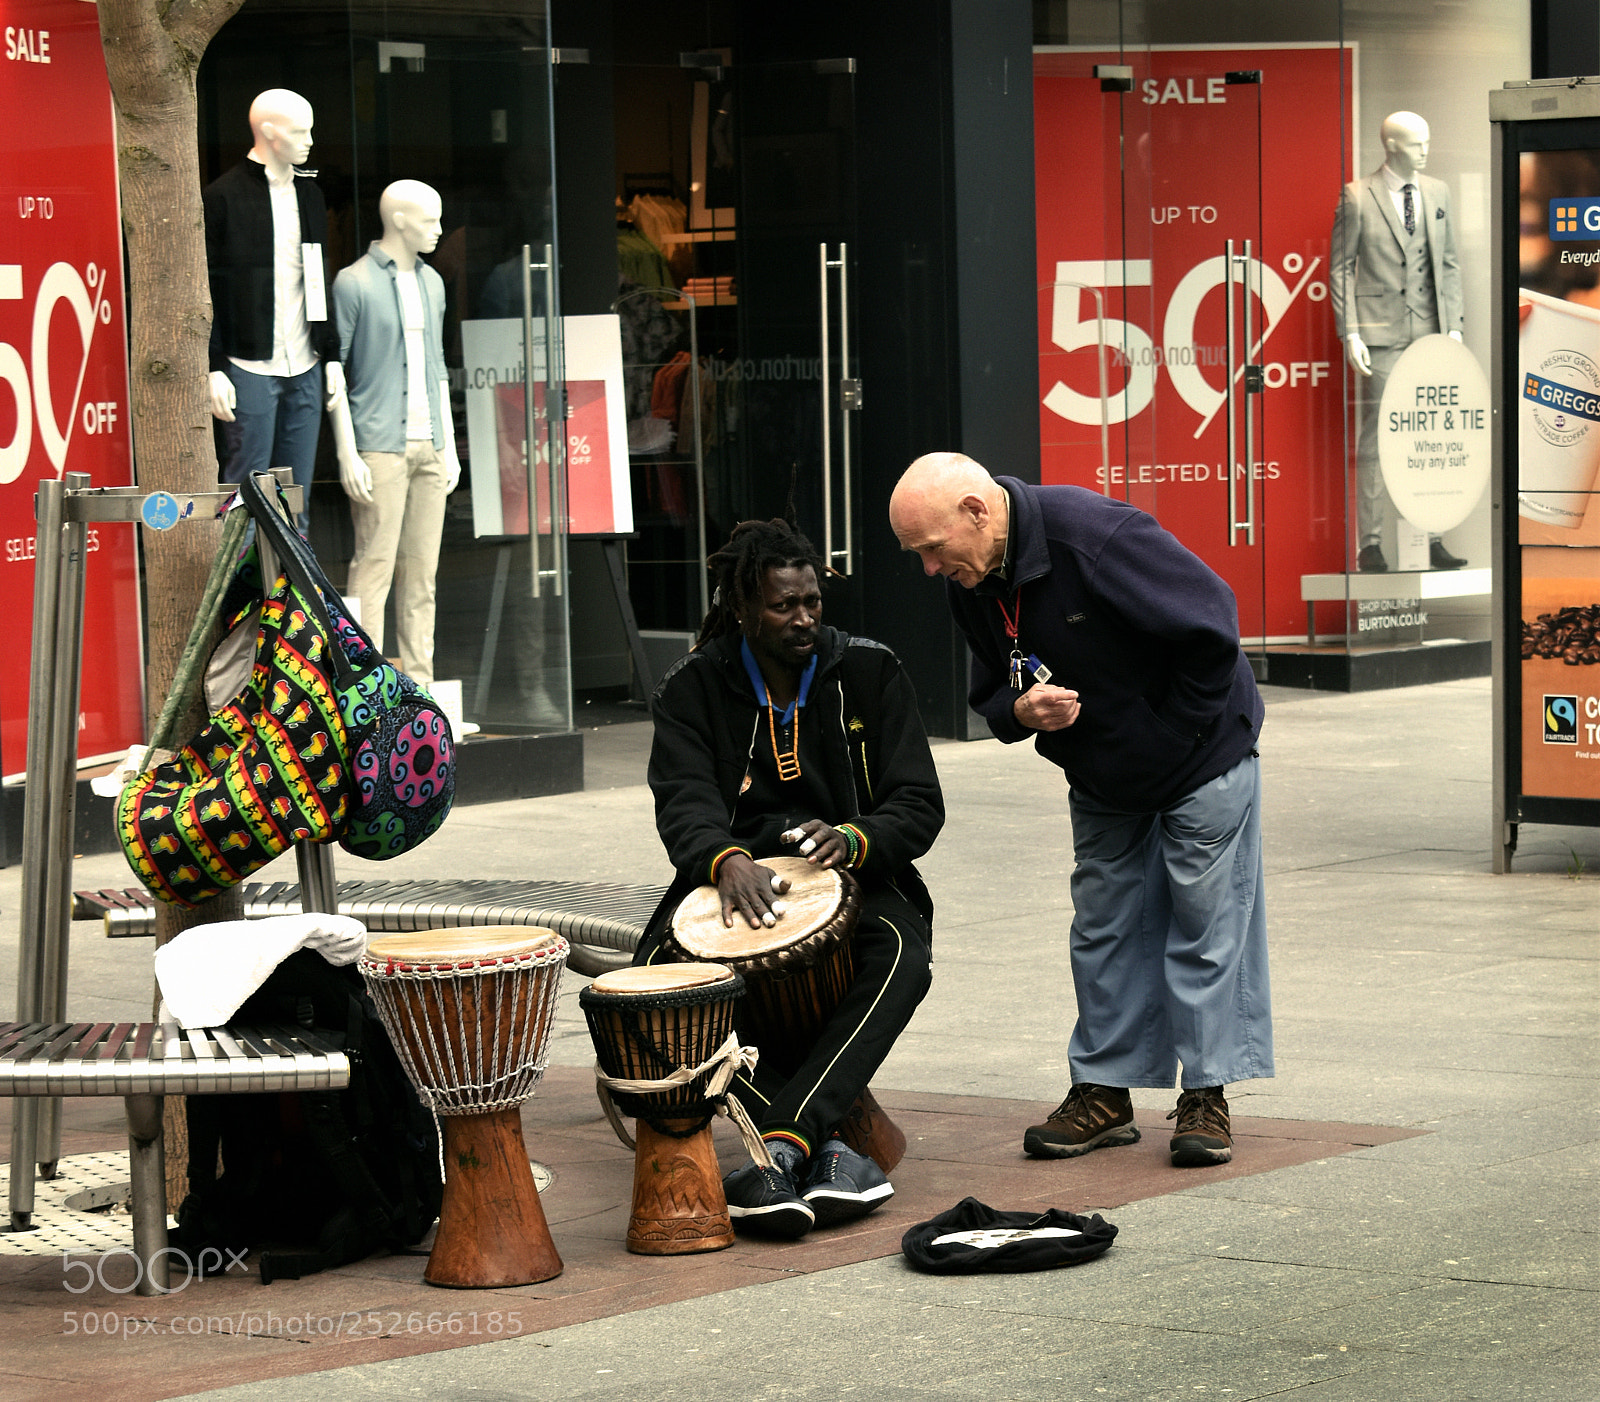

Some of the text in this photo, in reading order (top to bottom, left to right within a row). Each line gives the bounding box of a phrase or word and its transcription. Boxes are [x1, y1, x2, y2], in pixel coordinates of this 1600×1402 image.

[5, 26, 51, 64] SALE
[1141, 77, 1227, 105] SALE
[18, 197, 54, 220] UP TO
[1151, 206, 1218, 225] UP TO
[1042, 252, 1328, 440] 50%
[1540, 353, 1572, 372] FRESHLY
[1263, 361, 1330, 389] OFF
[1416, 385, 1459, 407] FREE
[82, 401, 118, 435] OFF
[1389, 409, 1485, 432] SHIRT & TIE
[1414, 440, 1464, 457] When you
[570, 456, 592, 465] OFF
[1407, 456, 1426, 471] buy
[1428, 458, 1447, 470] any
[1217, 462, 1281, 481] LNES
[156, 497, 168, 511] P
[1358, 612, 1429, 632] BURTON.CO.UK
[1545, 733, 1576, 742] FAIRTRADE
